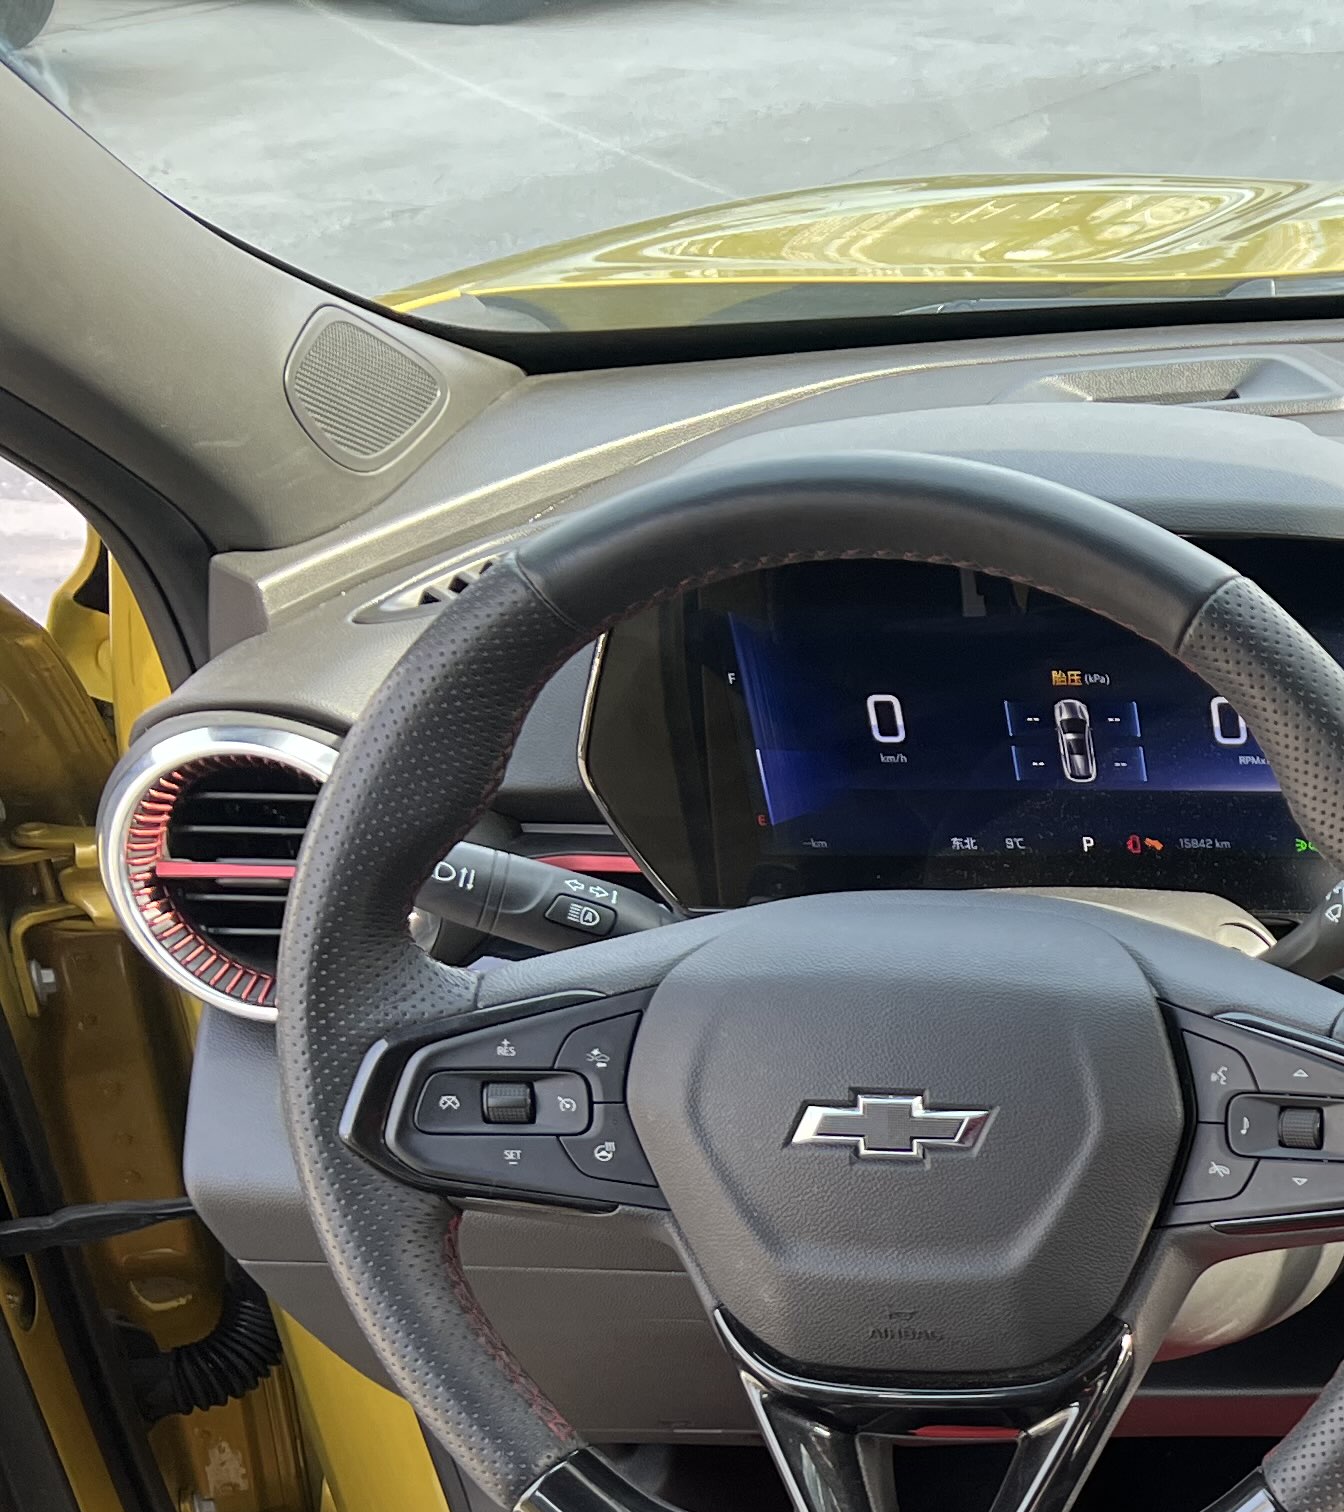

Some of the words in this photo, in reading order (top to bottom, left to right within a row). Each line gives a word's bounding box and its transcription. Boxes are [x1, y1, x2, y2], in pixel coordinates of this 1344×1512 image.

[727, 672, 736, 685] F
[1051, 670, 1083, 686] 胎压
[1084, 673, 1110, 686] (kPa)
[866, 694, 906, 743] 0
[1210, 696, 1248, 744] 0
[879, 753, 907, 763] km/h
[758, 814, 768, 827] E
[950, 837, 978, 850] 东北
[1082, 836, 1094, 852] P
[1179, 838, 1213, 849] 15842
[1215, 838, 1232, 849] km
[496, 1045, 517, 1056] RES
[503, 1149, 523, 1160] SET
[868, 1327, 945, 1342] AIRBAG
